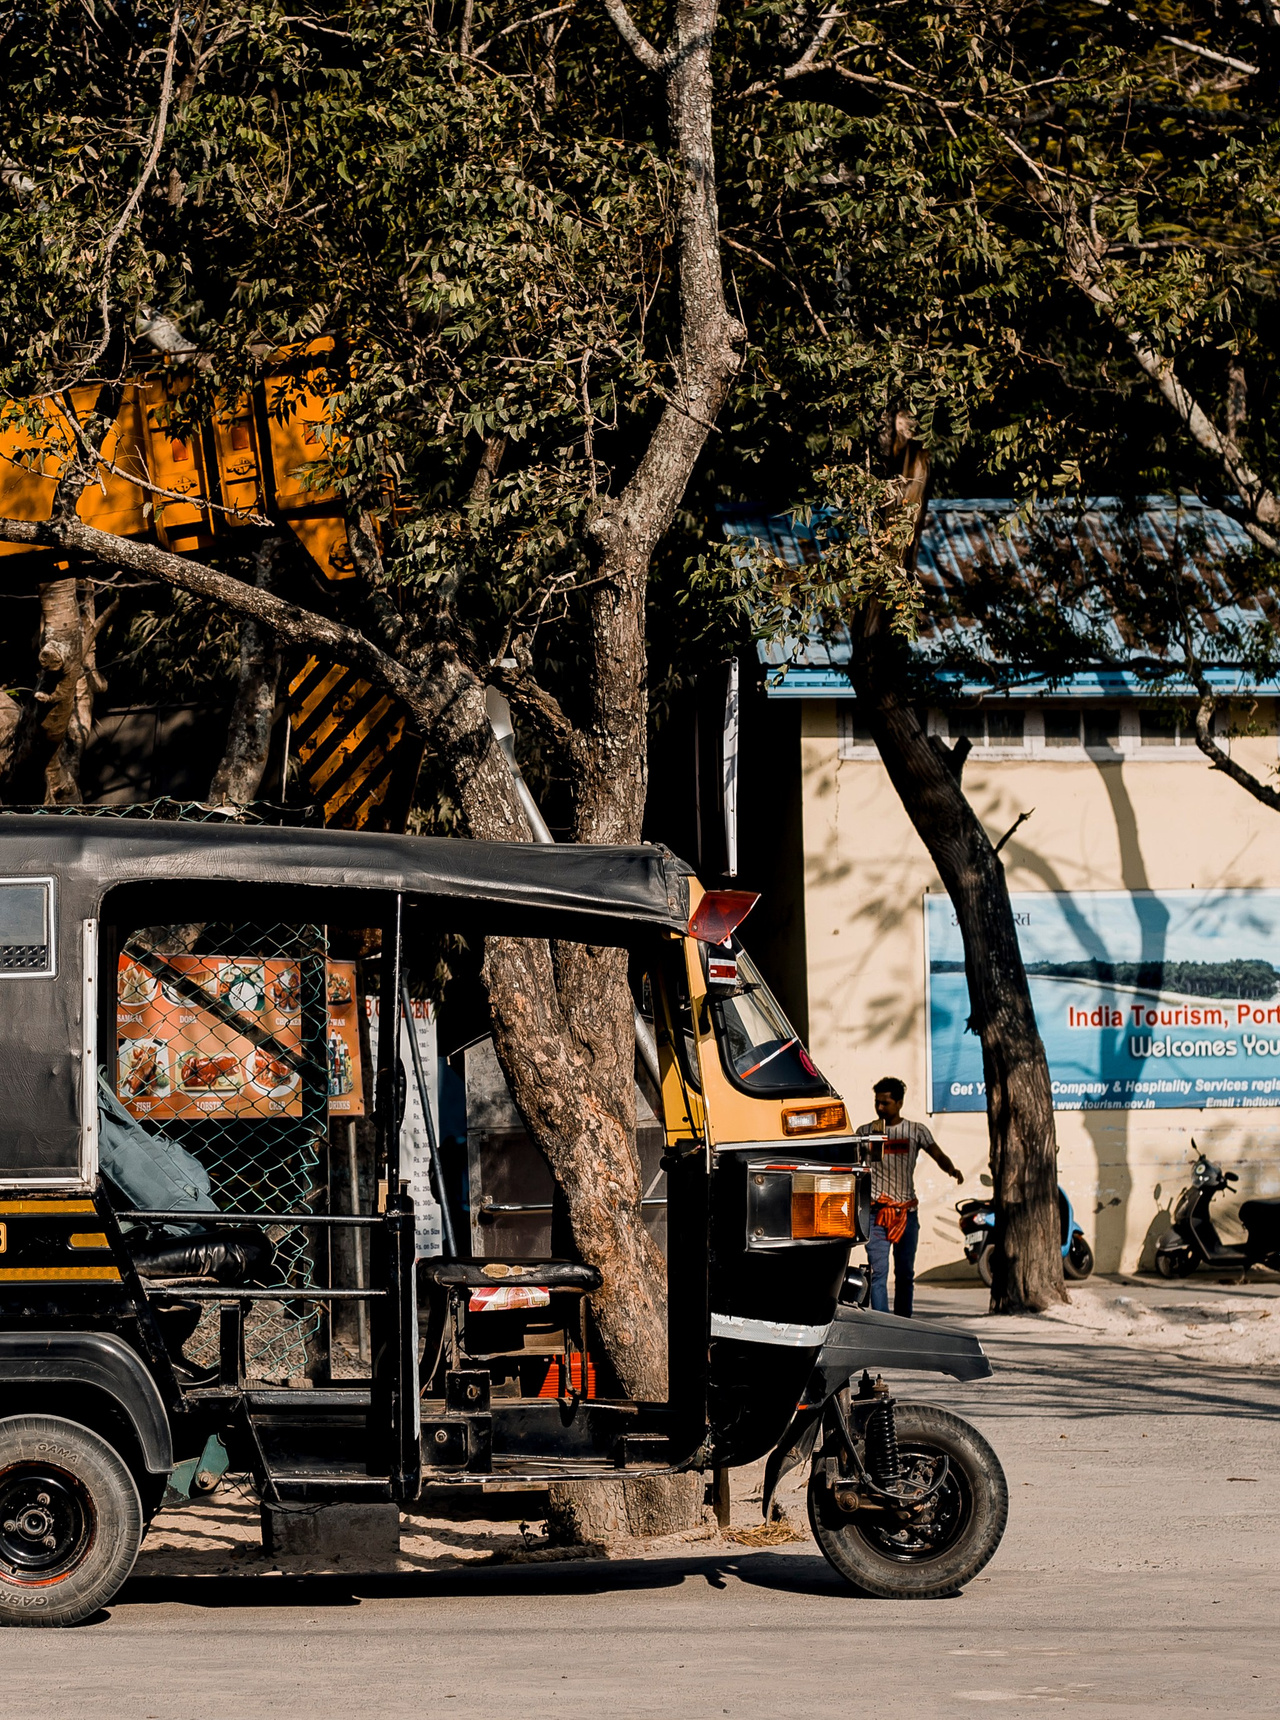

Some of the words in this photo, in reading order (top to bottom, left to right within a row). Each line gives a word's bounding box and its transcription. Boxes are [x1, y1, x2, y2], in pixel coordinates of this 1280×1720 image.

[1069, 1006, 1123, 1027] India
[1131, 1004, 1230, 1029] Tourism,
[1130, 1035, 1238, 1058] Welcomes
[950, 1081, 973, 1096] Get
[1051, 1080, 1109, 1096] Company
[1113, 1081, 1121, 1093] &
[1125, 1079, 1193, 1095] Hospitality
[1195, 1078, 1249, 1092] Services
[1251, 1077, 1280, 1094] regis
[136, 1101, 152, 1112] FISH
[1206, 1097, 1235, 1108] Email
[1242, 1096, 1280, 1107] indtour
[37, 1442, 80, 1463] GAMA
